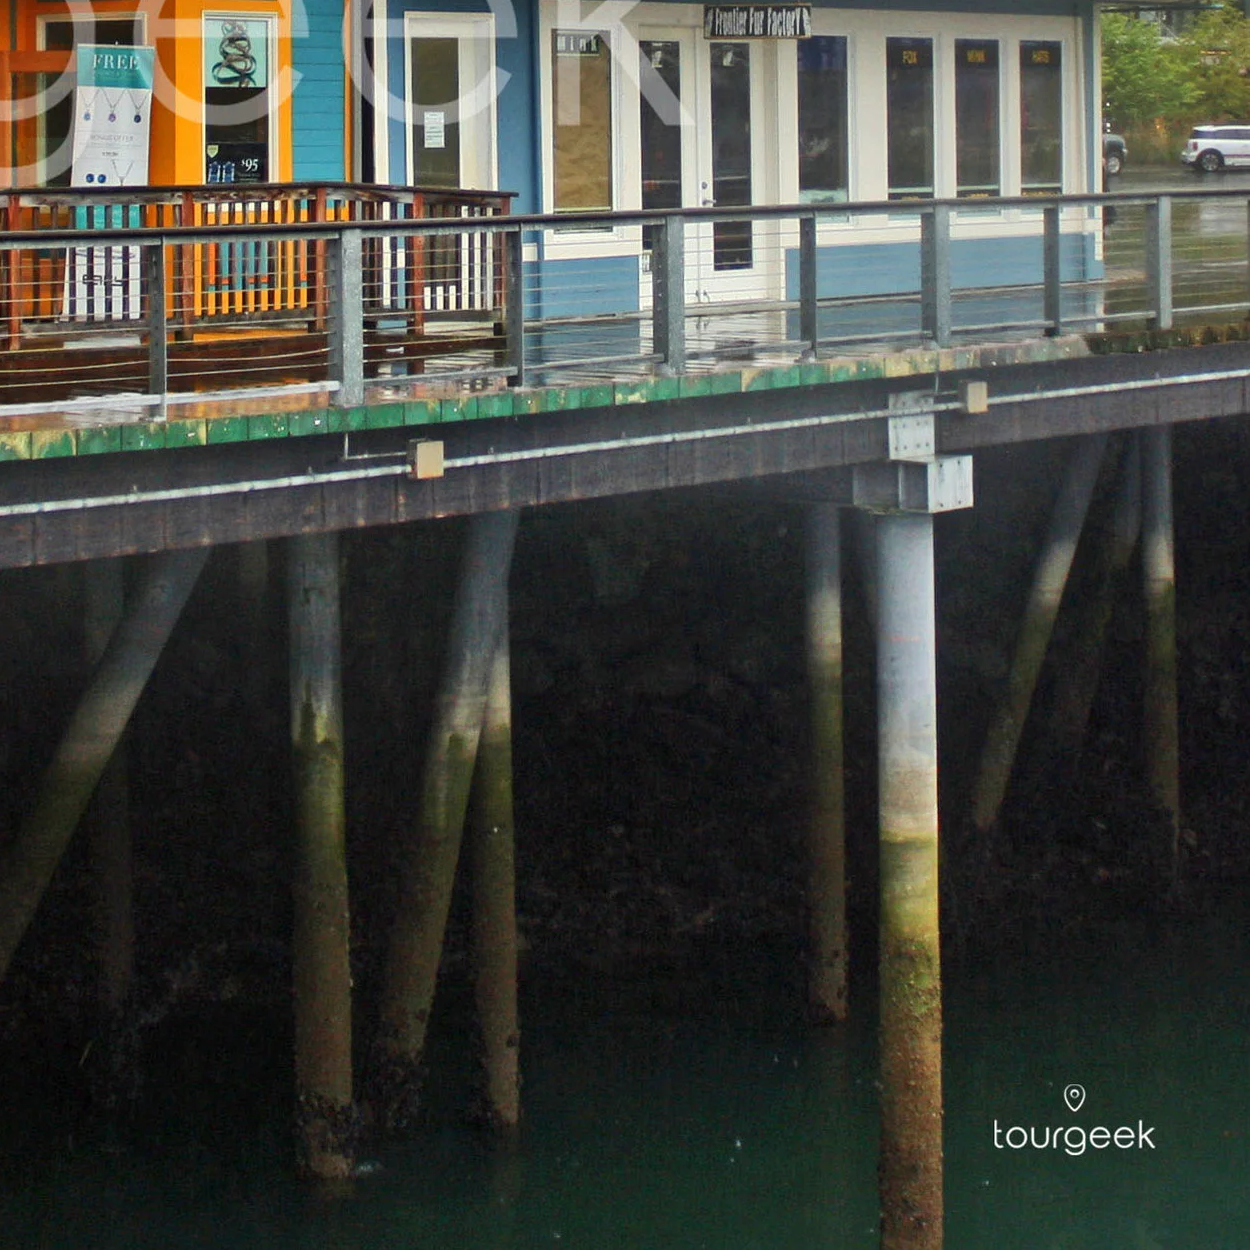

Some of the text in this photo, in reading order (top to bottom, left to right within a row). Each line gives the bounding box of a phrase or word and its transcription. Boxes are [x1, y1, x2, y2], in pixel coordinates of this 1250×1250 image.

[715, 7, 747, 36] Frontier
[749, 7, 764, 36] Fur
[93, 54, 139, 70] FREE
[241, 158, 259, 172] $95
